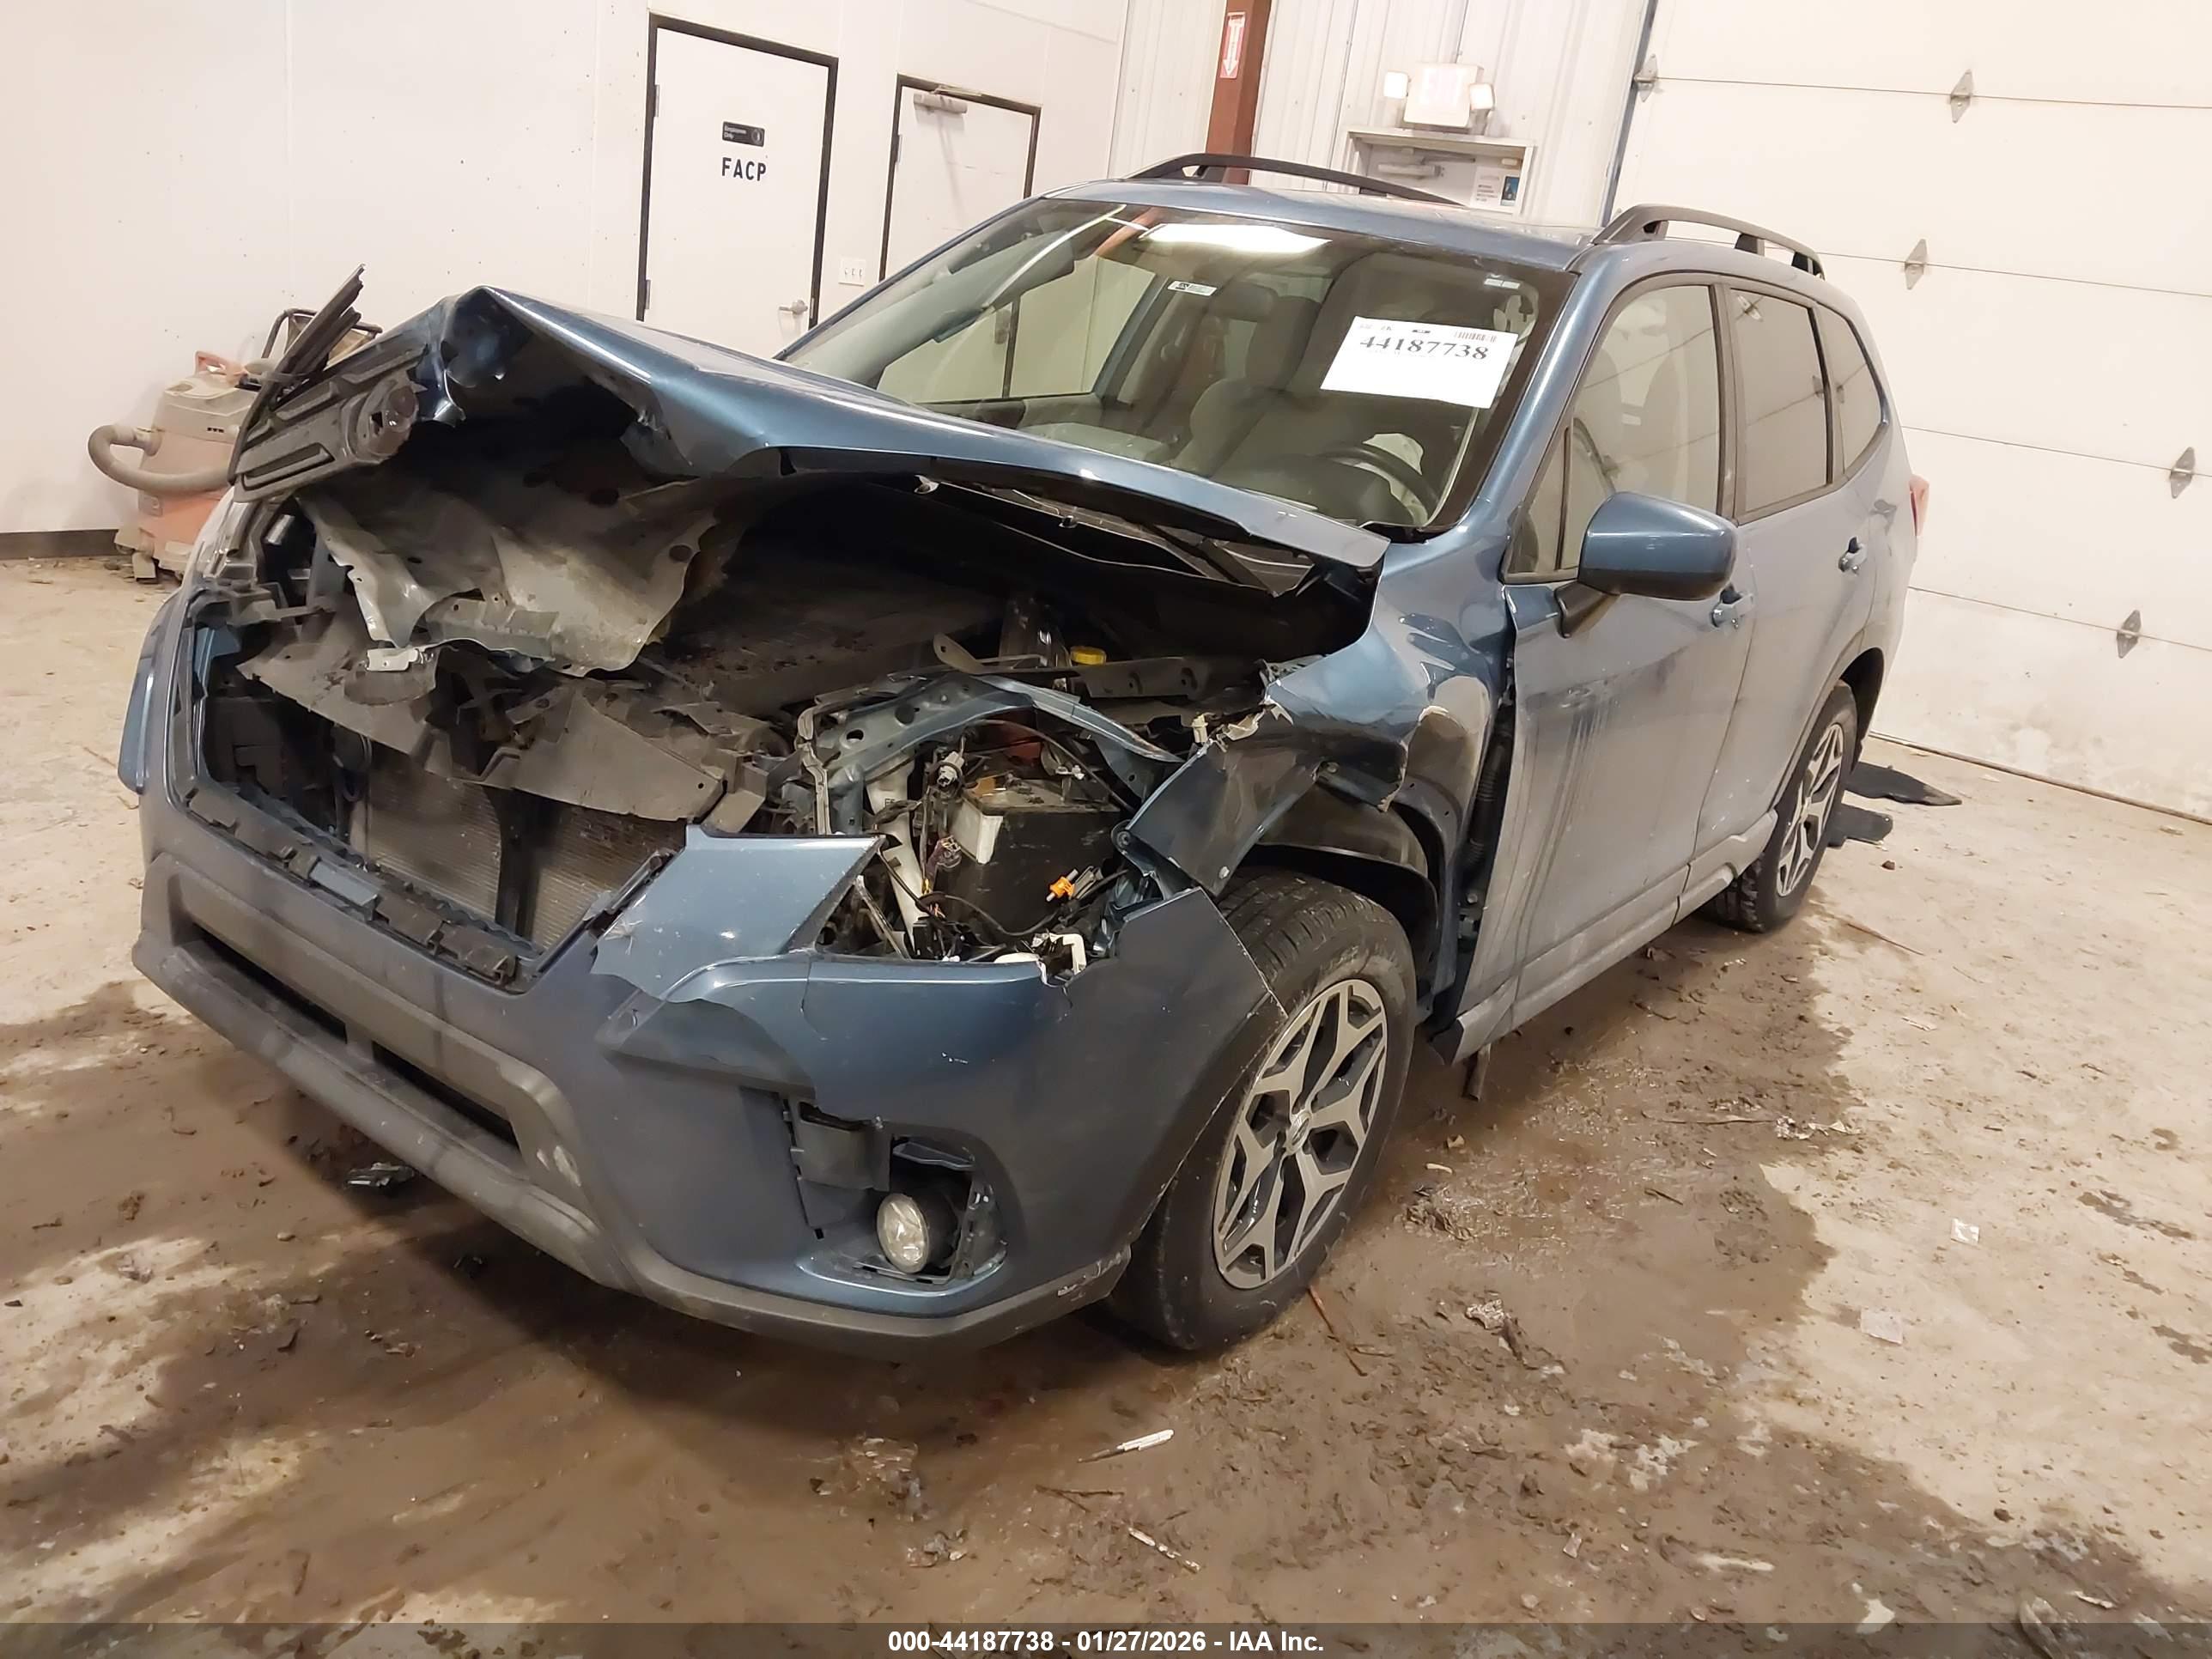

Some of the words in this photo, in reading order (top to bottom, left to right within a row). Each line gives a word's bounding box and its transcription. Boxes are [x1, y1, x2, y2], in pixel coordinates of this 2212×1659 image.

[1419, 67, 1467, 107] ET
[721, 157, 766, 181] FACP
[1360, 336, 1489, 360] 44187738
